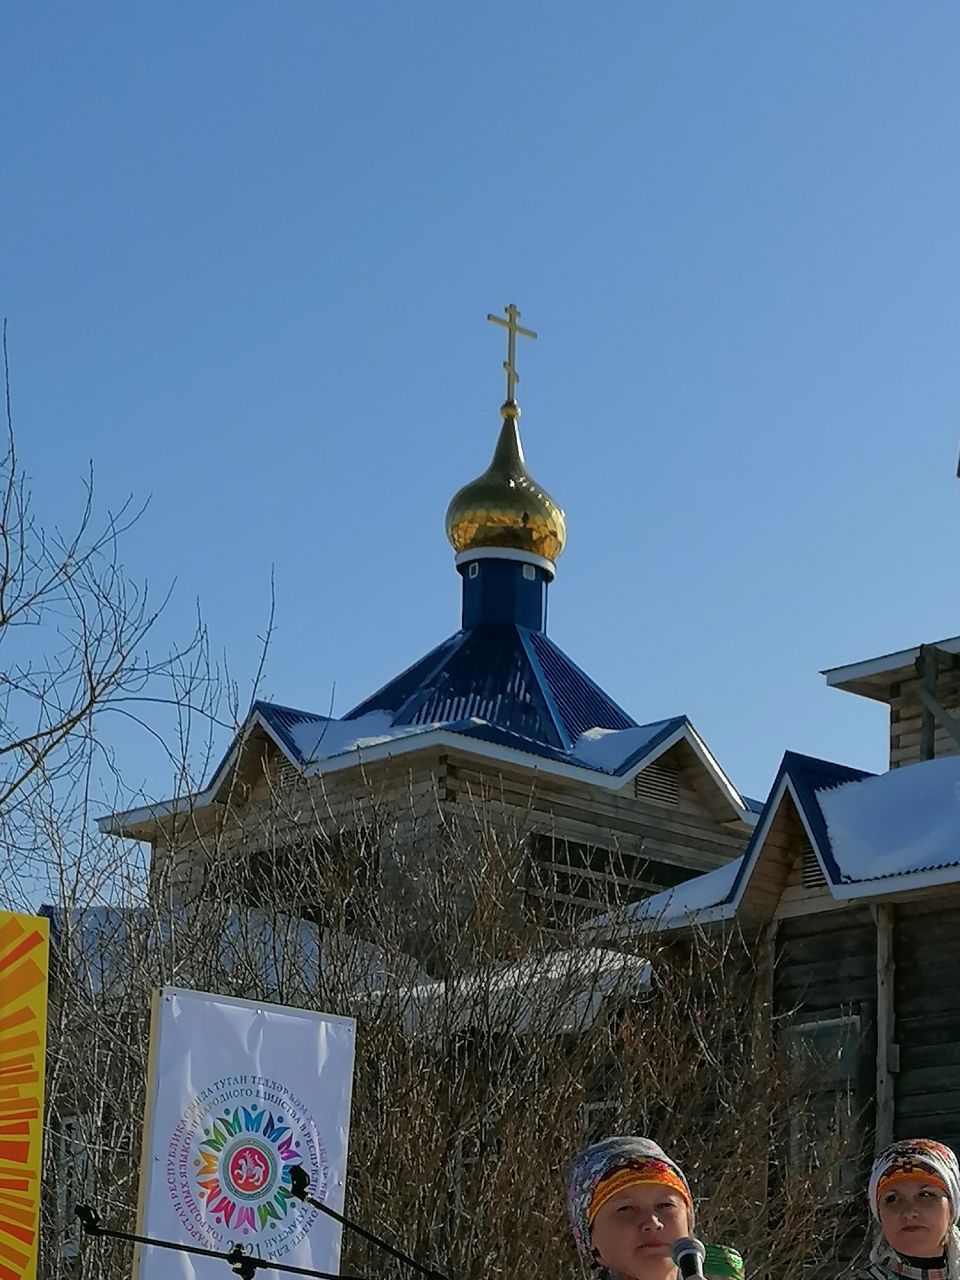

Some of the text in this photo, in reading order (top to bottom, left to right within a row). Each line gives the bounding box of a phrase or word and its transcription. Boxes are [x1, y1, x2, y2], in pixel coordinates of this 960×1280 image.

[214, 1075, 246, 1091] ТУГАН
[252, 1075, 289, 1095] ТЕЛЛӘР
[196, 1088, 251, 1120] НАРОДНОГО
[256, 1089, 302, 1124] ЕДИНСТВА
[167, 1086, 212, 1199] РЕСПУБЛИКАСЫНДА
[179, 1128, 194, 1178] ЯЗЫКОВ
[303, 1131, 318, 1198] РЕСПУБЛИ
[180, 1181, 206, 1228] РОДНЫХ
[289, 1182, 328, 1247] БЕРӘМЛЕГЕ
[173, 1201, 217, 1254] АТАРСТАН
[205, 1224, 222, 1242] ГОД
[264, 1207, 308, 1247] ТАТАРСТАН
[226, 1239, 261, 1259] 221
[268, 1243, 288, 1259] ЕЛЫ
